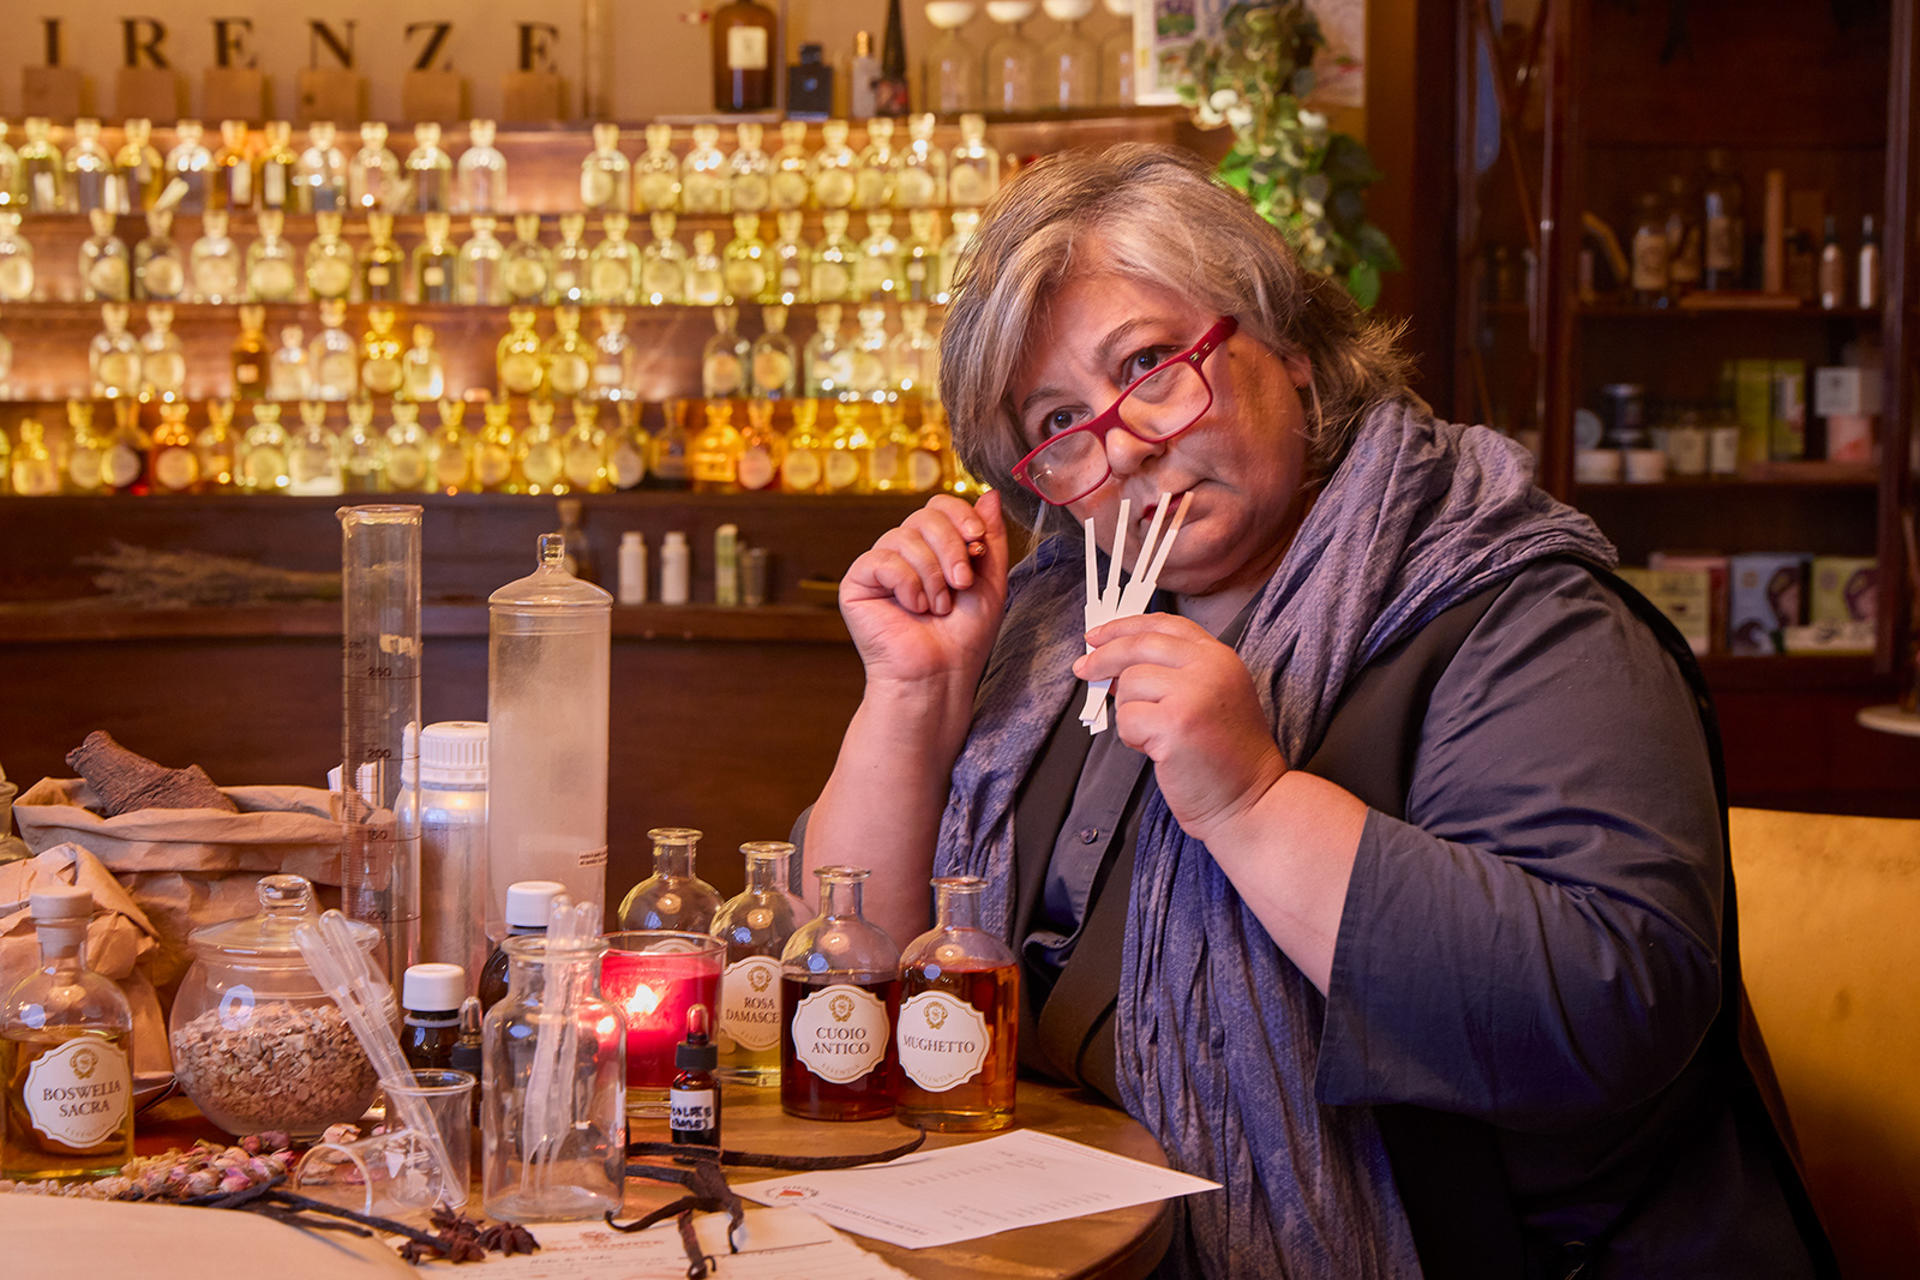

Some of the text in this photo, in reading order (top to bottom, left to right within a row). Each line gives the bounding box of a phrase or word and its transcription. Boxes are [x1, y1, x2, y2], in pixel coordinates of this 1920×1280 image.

[367, 748, 392, 759] 200
[743, 996, 776, 1010] ROSA
[815, 1027, 867, 1041] CUOIO
[811, 1041, 871, 1055] ANTICO
[903, 1034, 976, 1054] MUGHETTO
[59, 1100, 110, 1118] SACRA
